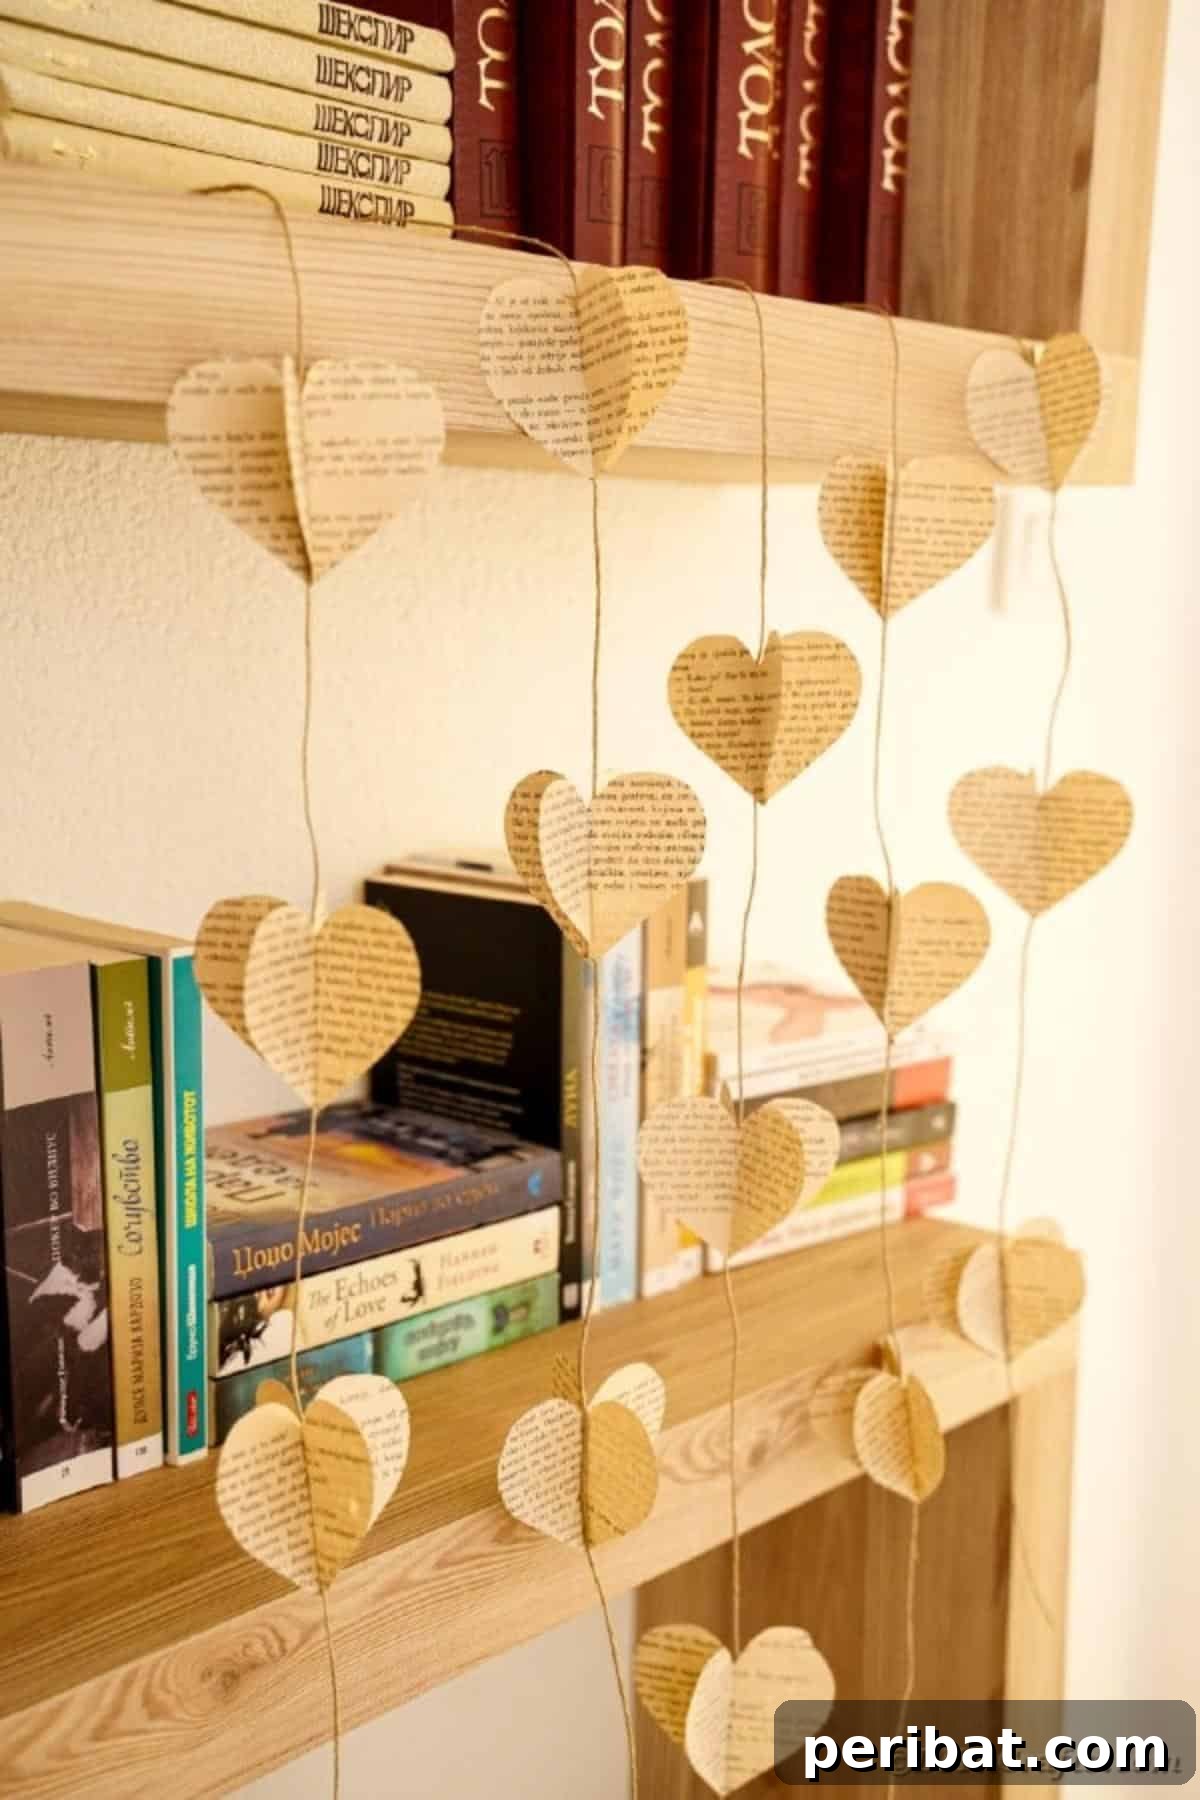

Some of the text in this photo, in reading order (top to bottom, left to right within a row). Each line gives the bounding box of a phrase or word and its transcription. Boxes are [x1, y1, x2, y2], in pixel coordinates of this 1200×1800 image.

[317, 2, 415, 55] ШЕКСПИР
[315, 53, 413, 103] ШЕКСПИР
[313, 103, 412, 148] ШЕКСПИР
[317, 141, 412, 185] ШЕКСПИР
[317, 183, 416, 228] ШЕКСПИР
[111, 1137, 145, 1257] Сочувство
[334, 1264, 399, 1302] Echoes
[343, 1296, 388, 1323] Love
